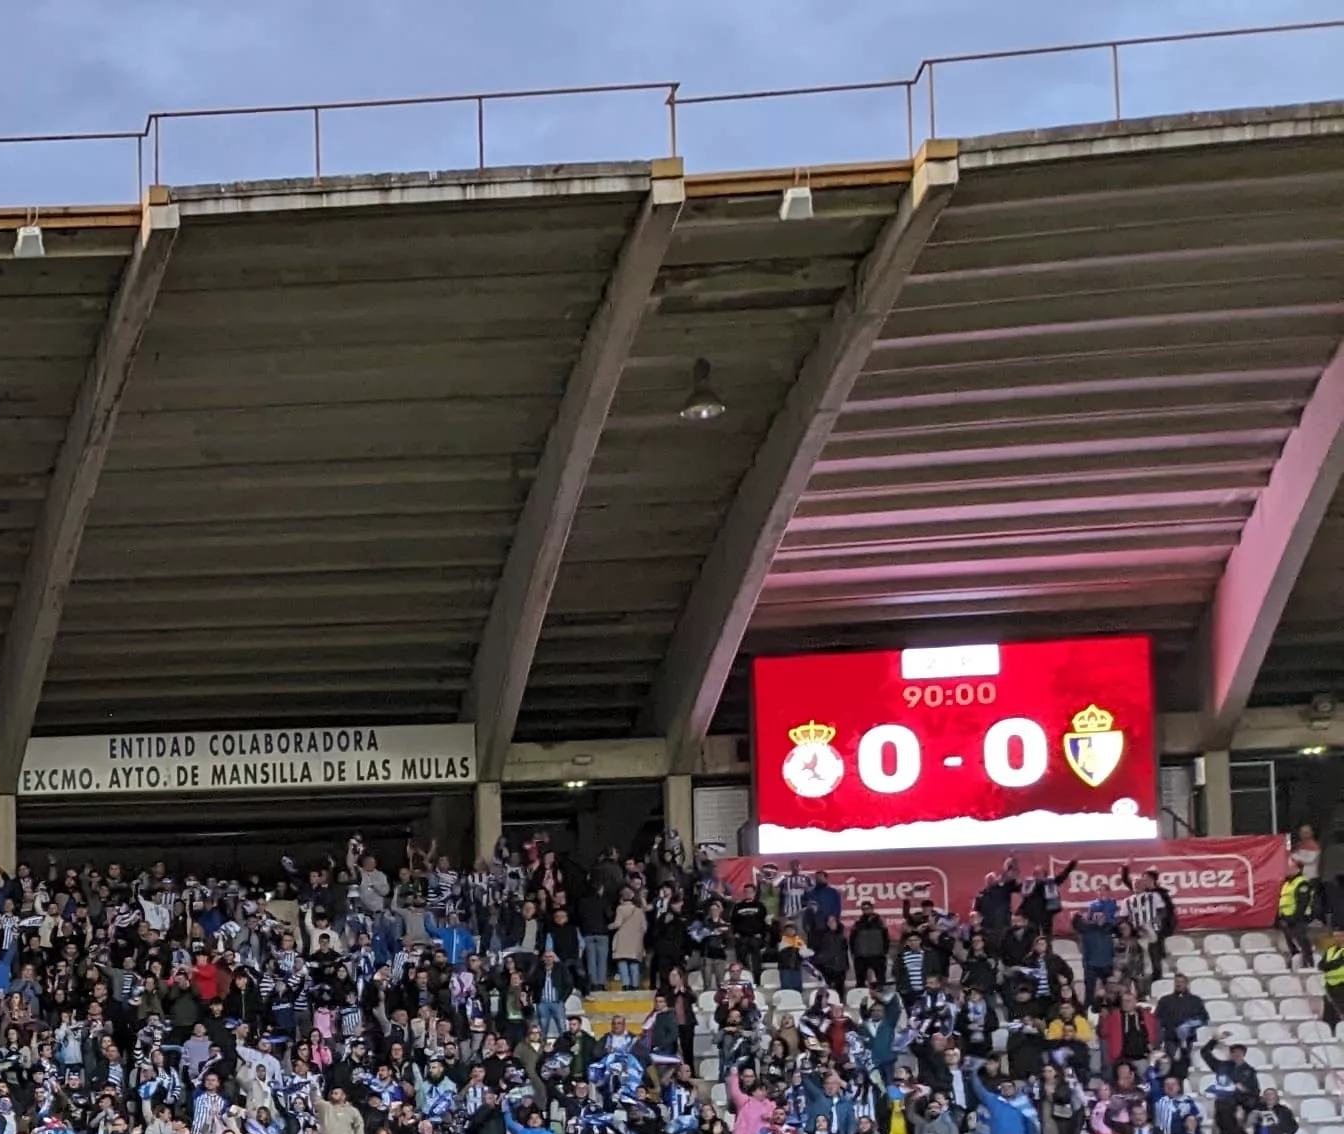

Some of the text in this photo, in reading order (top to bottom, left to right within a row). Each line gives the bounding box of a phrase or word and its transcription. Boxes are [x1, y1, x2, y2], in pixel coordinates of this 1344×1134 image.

[902, 682, 997, 708] 90:00
[109, 729, 379, 759] ENTIDAD COLABORADORA
[858, 723, 921, 794] 0
[984, 717, 1047, 788] 0
[23, 756, 471, 791] EXCMO. AYTO. DE MANSILLA DE LAS MULAS
